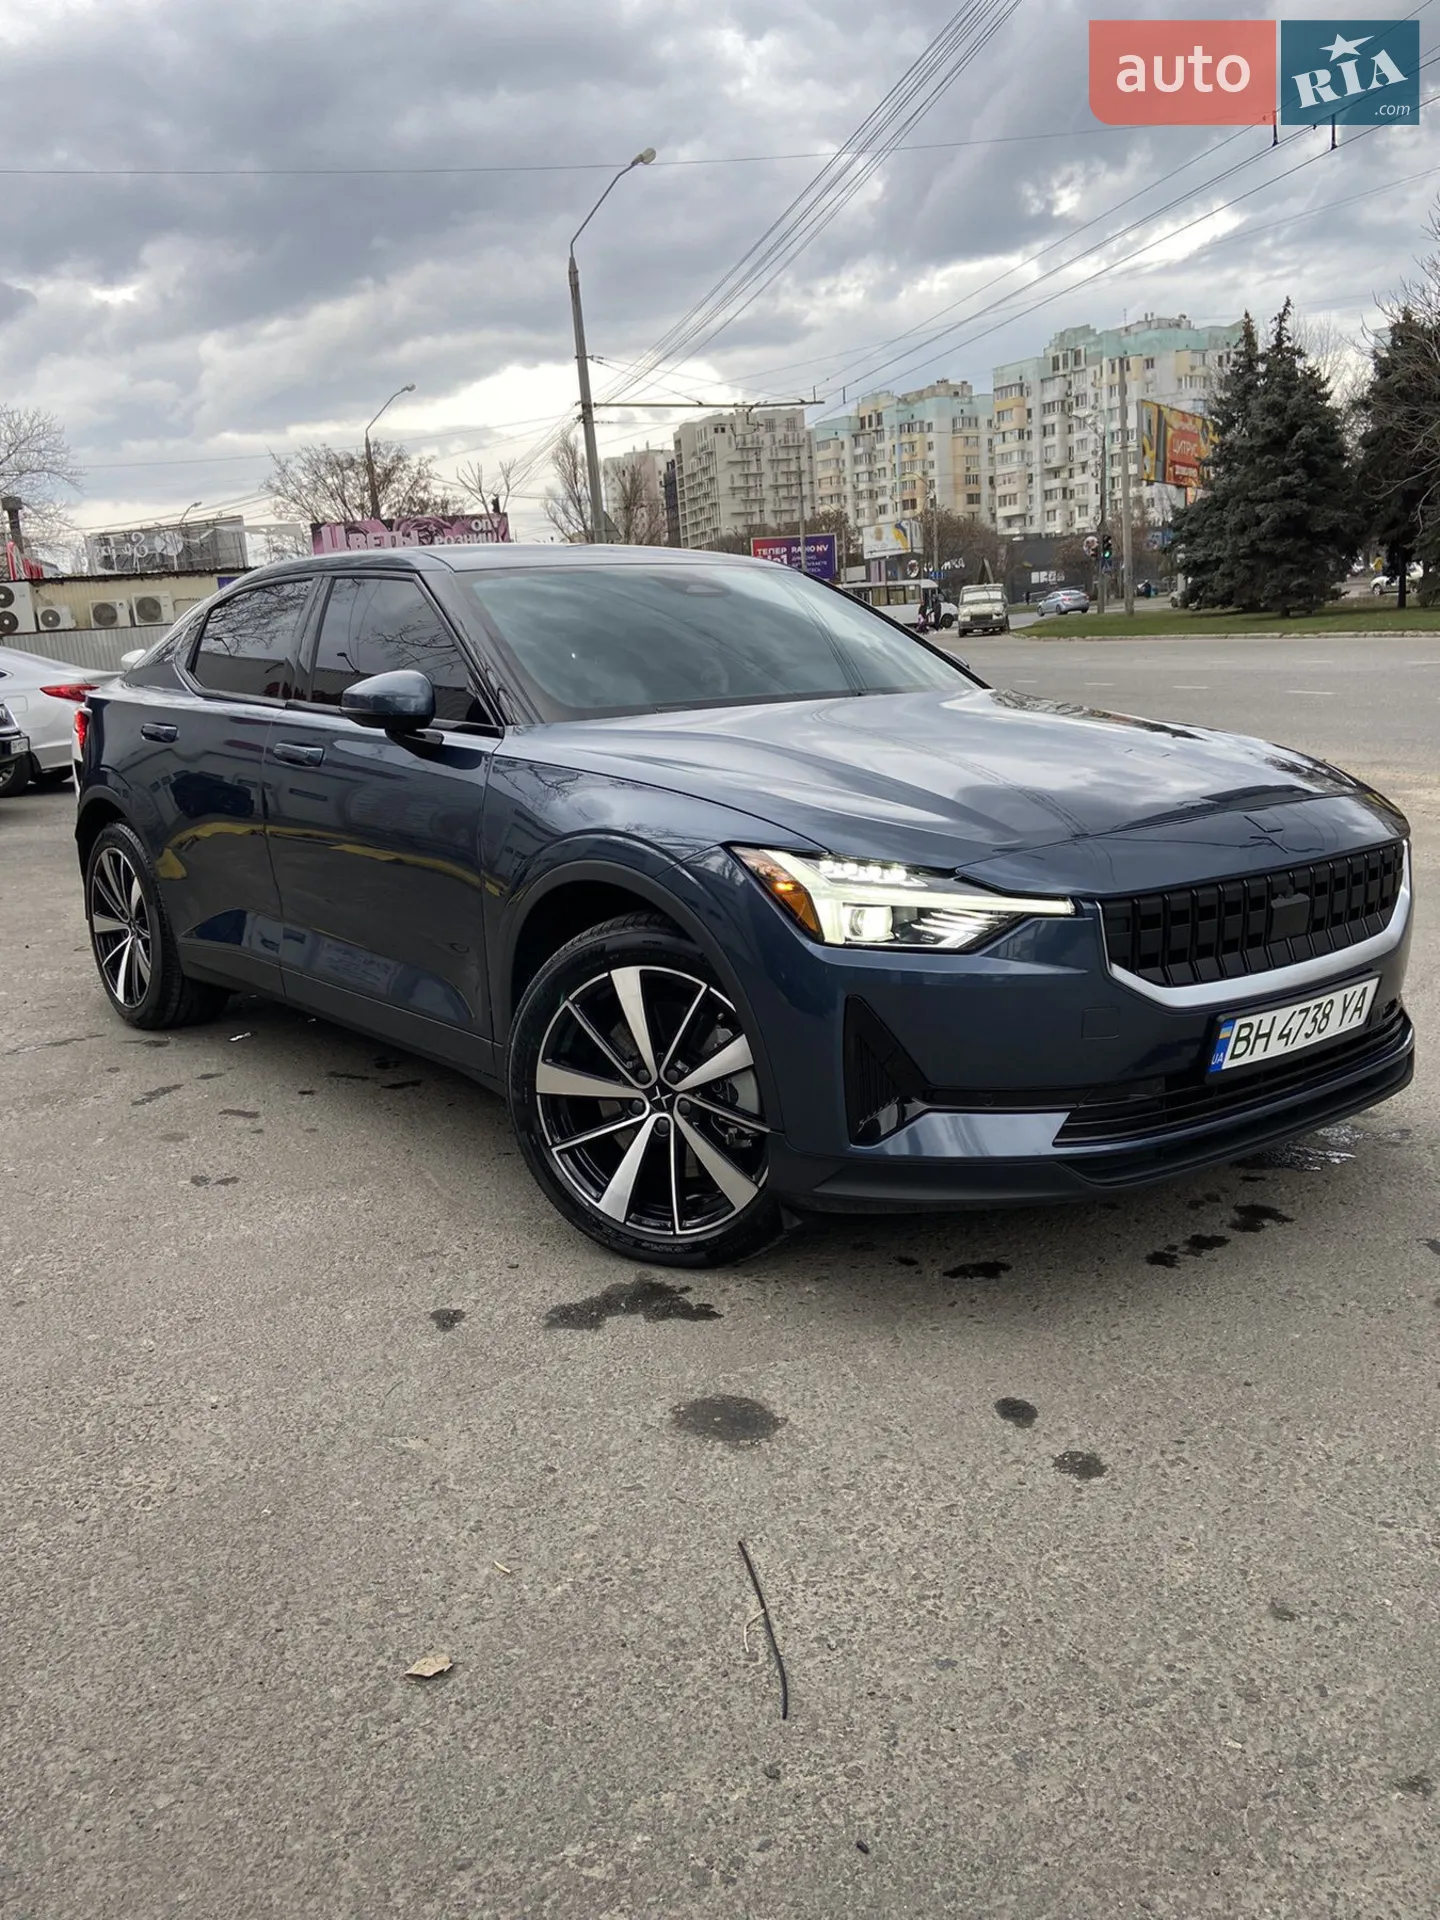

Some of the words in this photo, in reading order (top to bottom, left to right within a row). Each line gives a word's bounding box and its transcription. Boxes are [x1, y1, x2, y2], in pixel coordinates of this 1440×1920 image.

[1229, 1015, 1277, 1060] BH
[1277, 998, 1335, 1048] 4738
[1338, 986, 1369, 1028] YA
[1211, 1055, 1224, 1065] UA
